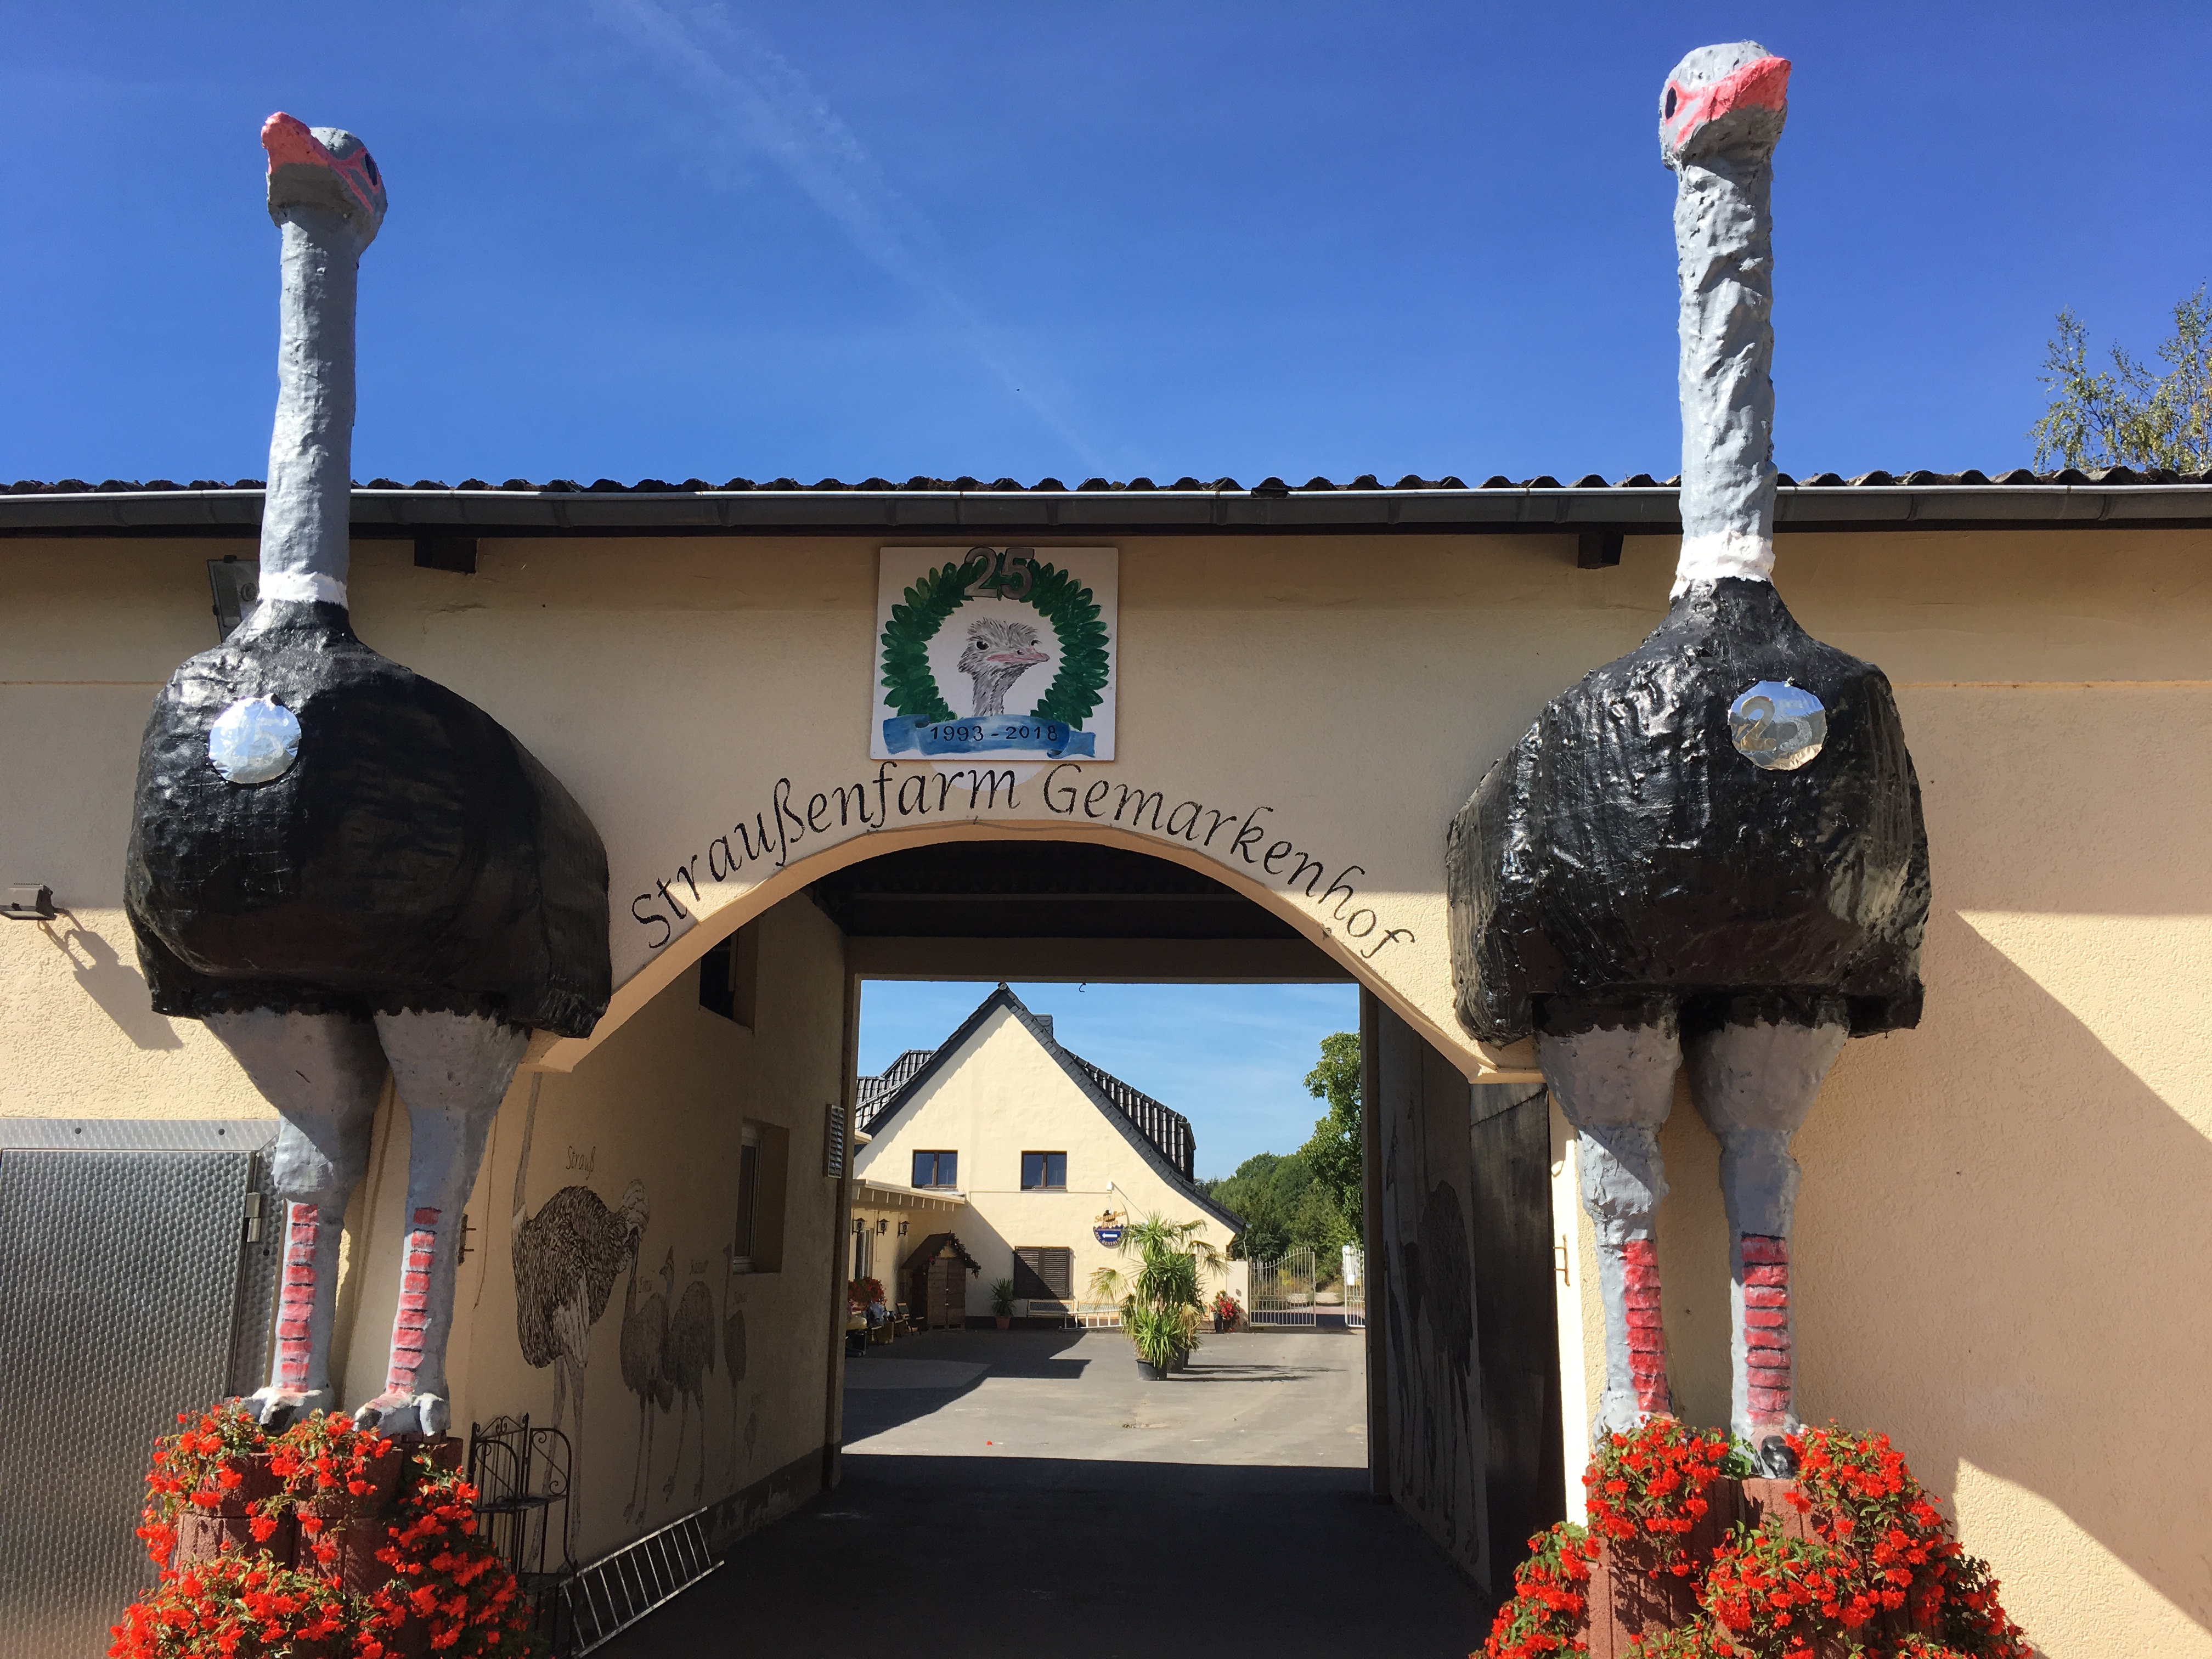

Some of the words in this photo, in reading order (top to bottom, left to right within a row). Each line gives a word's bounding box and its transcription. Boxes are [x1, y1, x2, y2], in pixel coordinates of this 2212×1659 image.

[964, 547, 1035, 600] 25
[1740, 695, 1812, 752] 25
[631, 761, 1022, 948] Straußenfarm
[1043, 763, 1415, 958] Gemarkenhof
